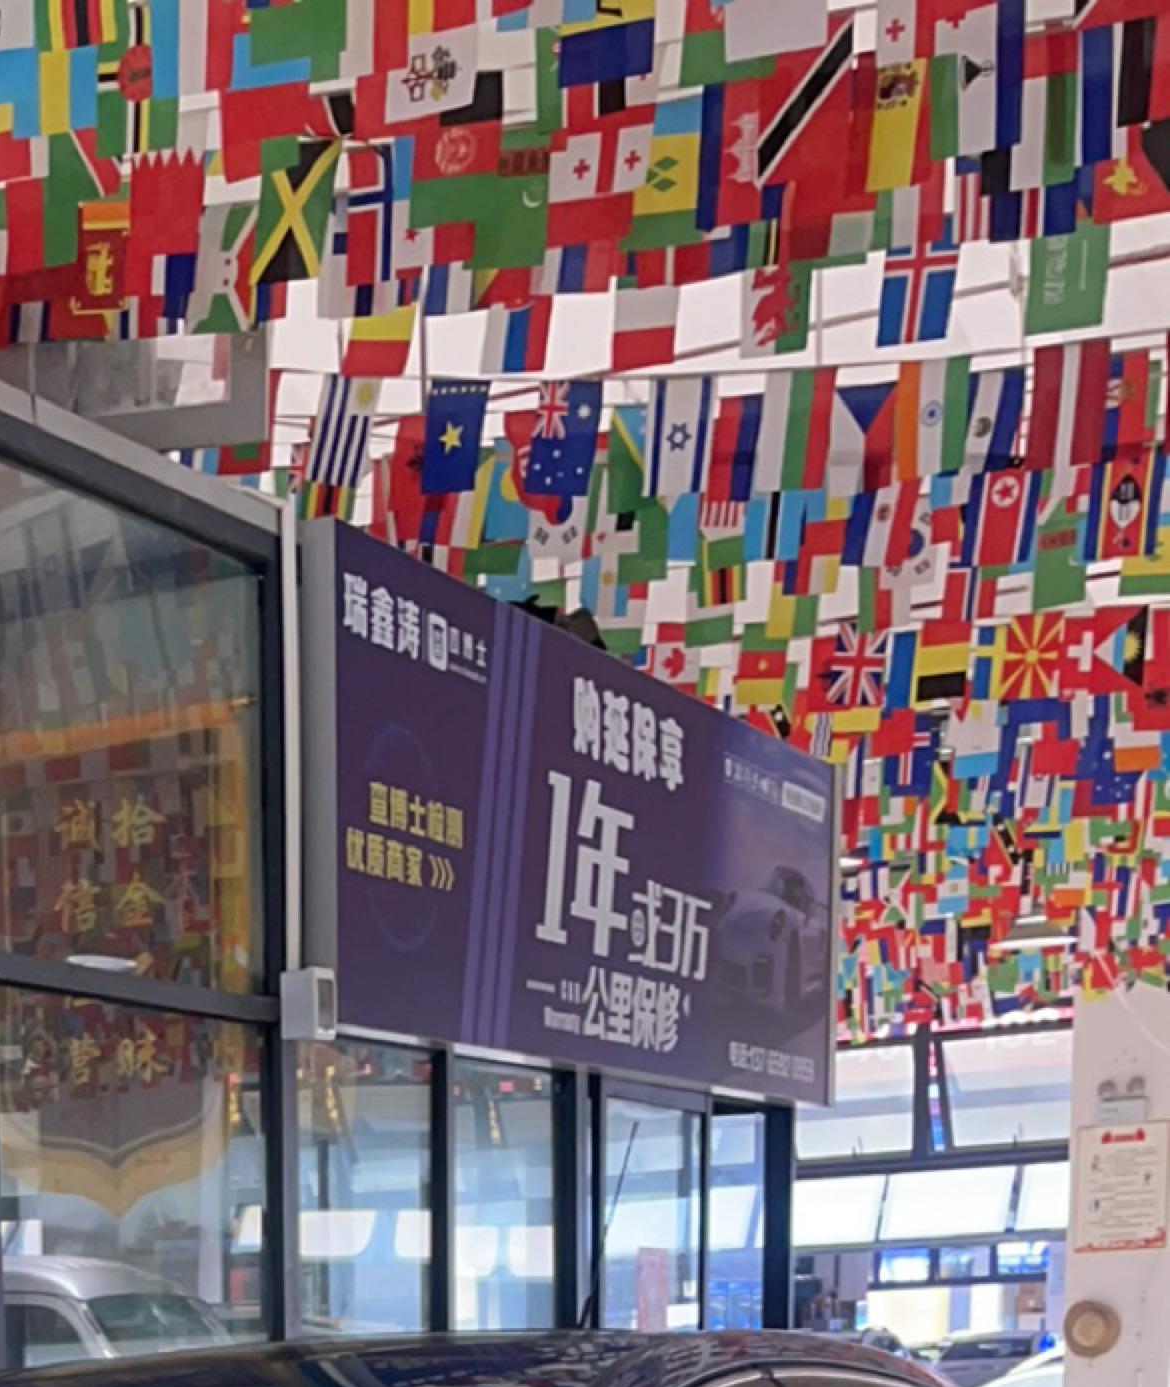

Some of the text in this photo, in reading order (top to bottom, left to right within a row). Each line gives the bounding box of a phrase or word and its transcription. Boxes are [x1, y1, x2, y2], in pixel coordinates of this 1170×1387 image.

[573, 676, 684, 791] 购延保享
[346, 826, 422, 887] 优质商家
[582, 965, 681, 1052] 公里保修
